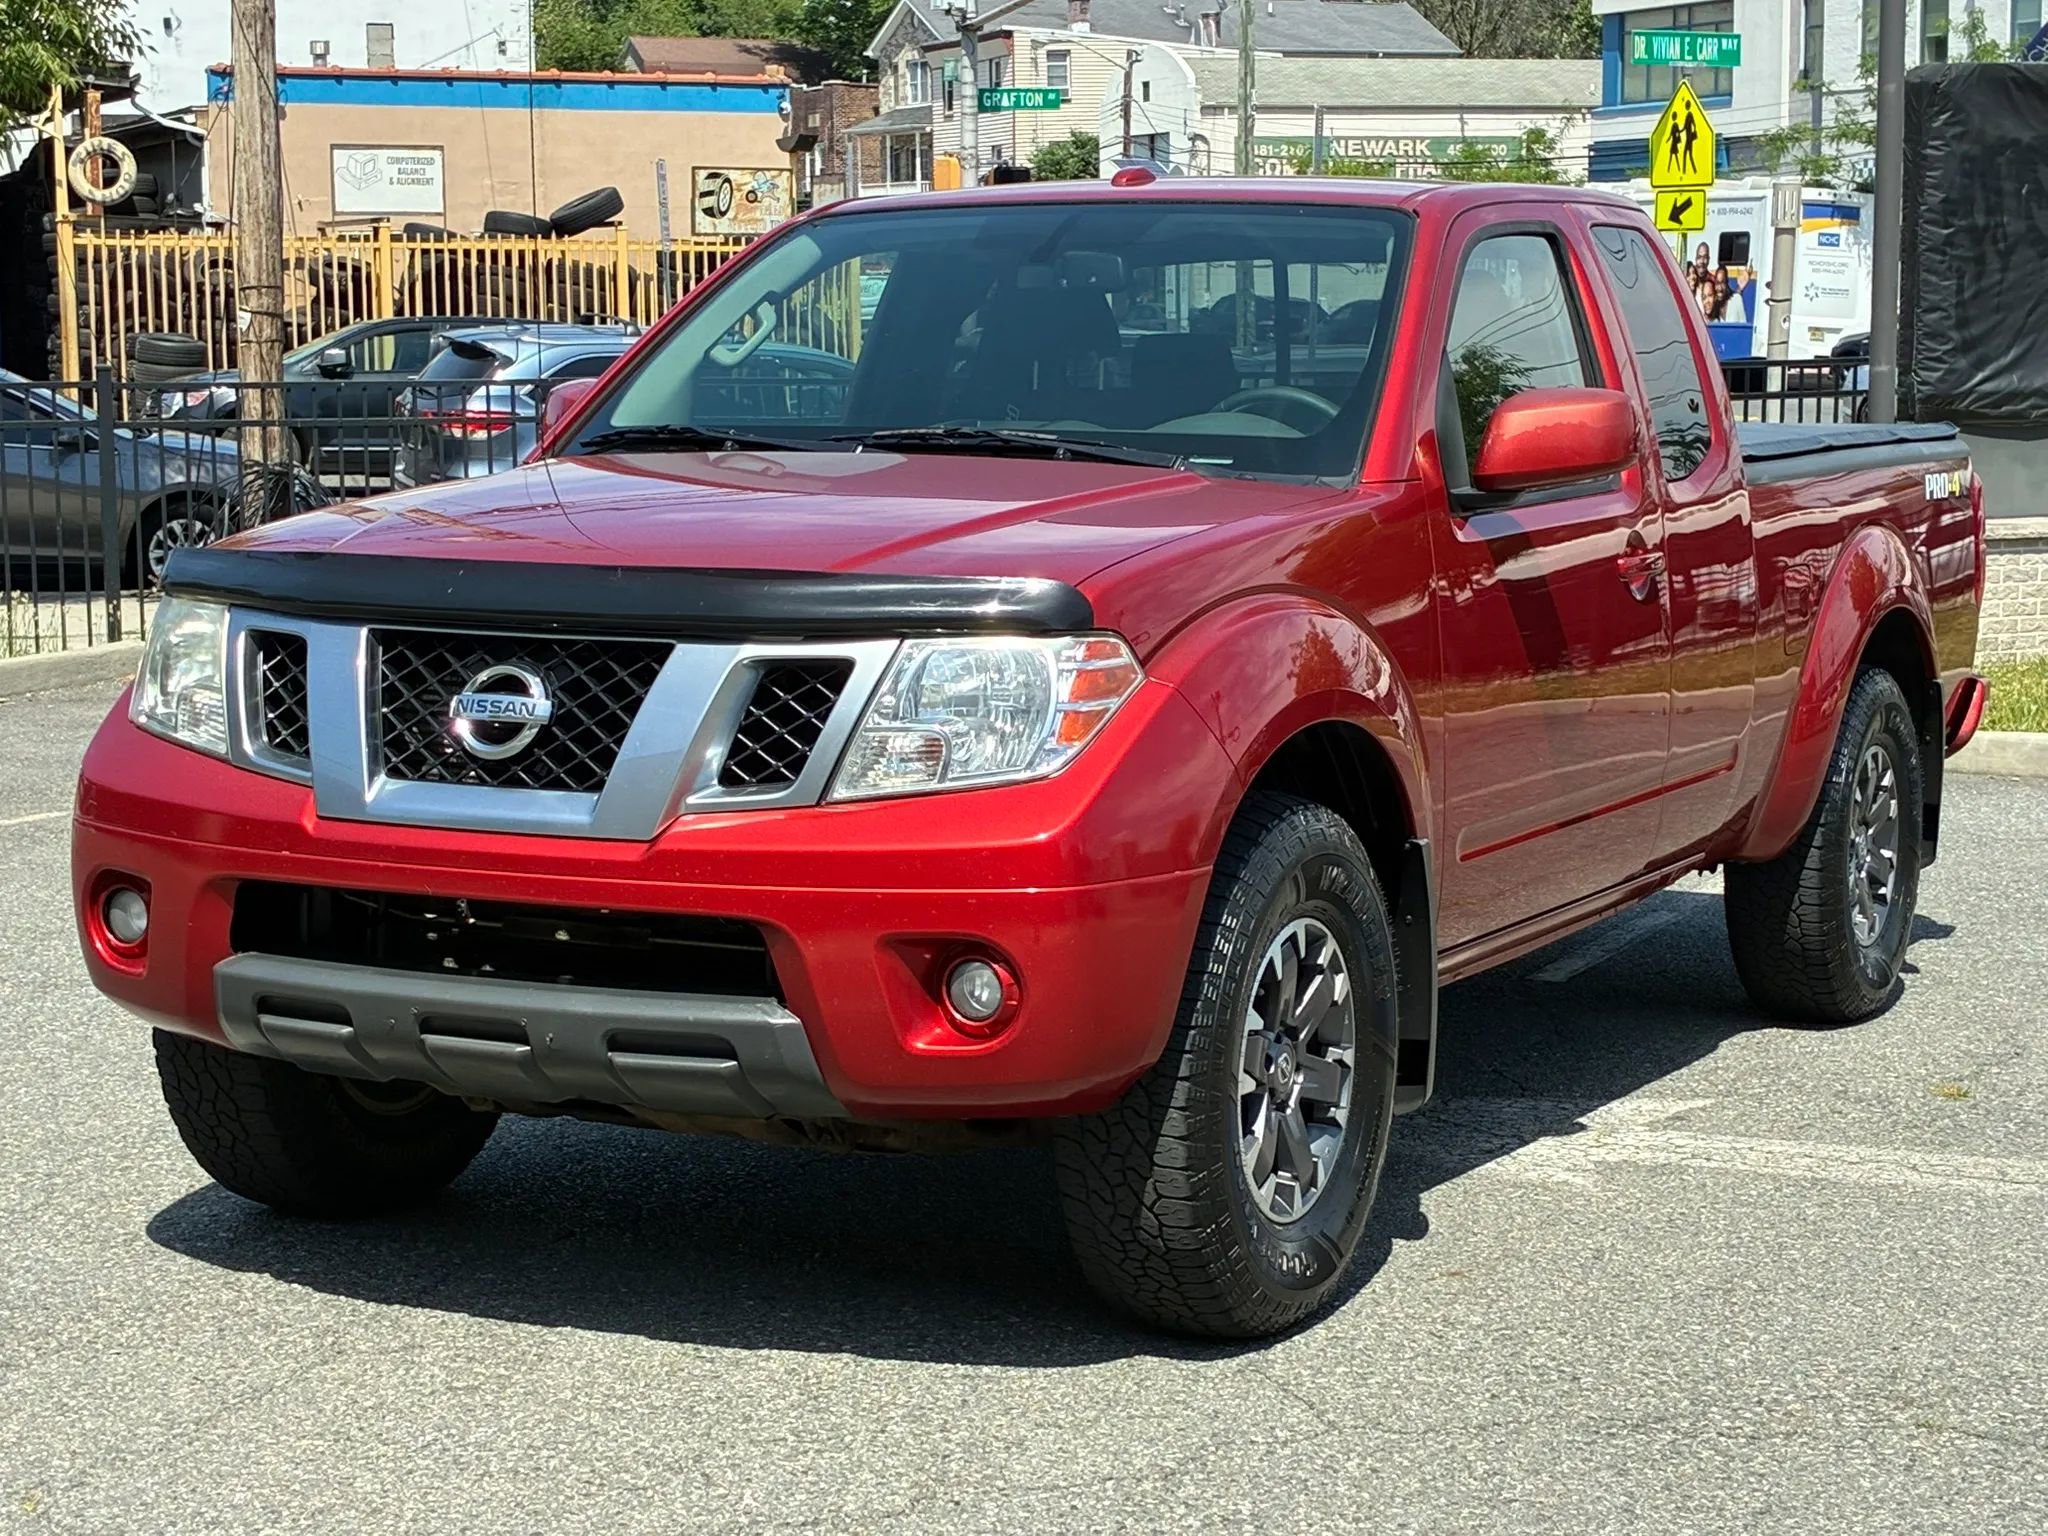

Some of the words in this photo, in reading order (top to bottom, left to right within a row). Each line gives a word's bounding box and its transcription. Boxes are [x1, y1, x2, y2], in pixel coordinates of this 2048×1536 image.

[1634, 35, 1648, 59] DR.
[1652, 36, 1680, 60] VIVIAN
[1697, 37, 1719, 61] CARR
[1721, 38, 1739, 51] WAY
[983, 92, 1043, 107] GRAFTON
[1330, 139, 1432, 156] NEWARK
[396, 177, 435, 186] ALIGNMENT
[457, 698, 537, 717] NISSAN
